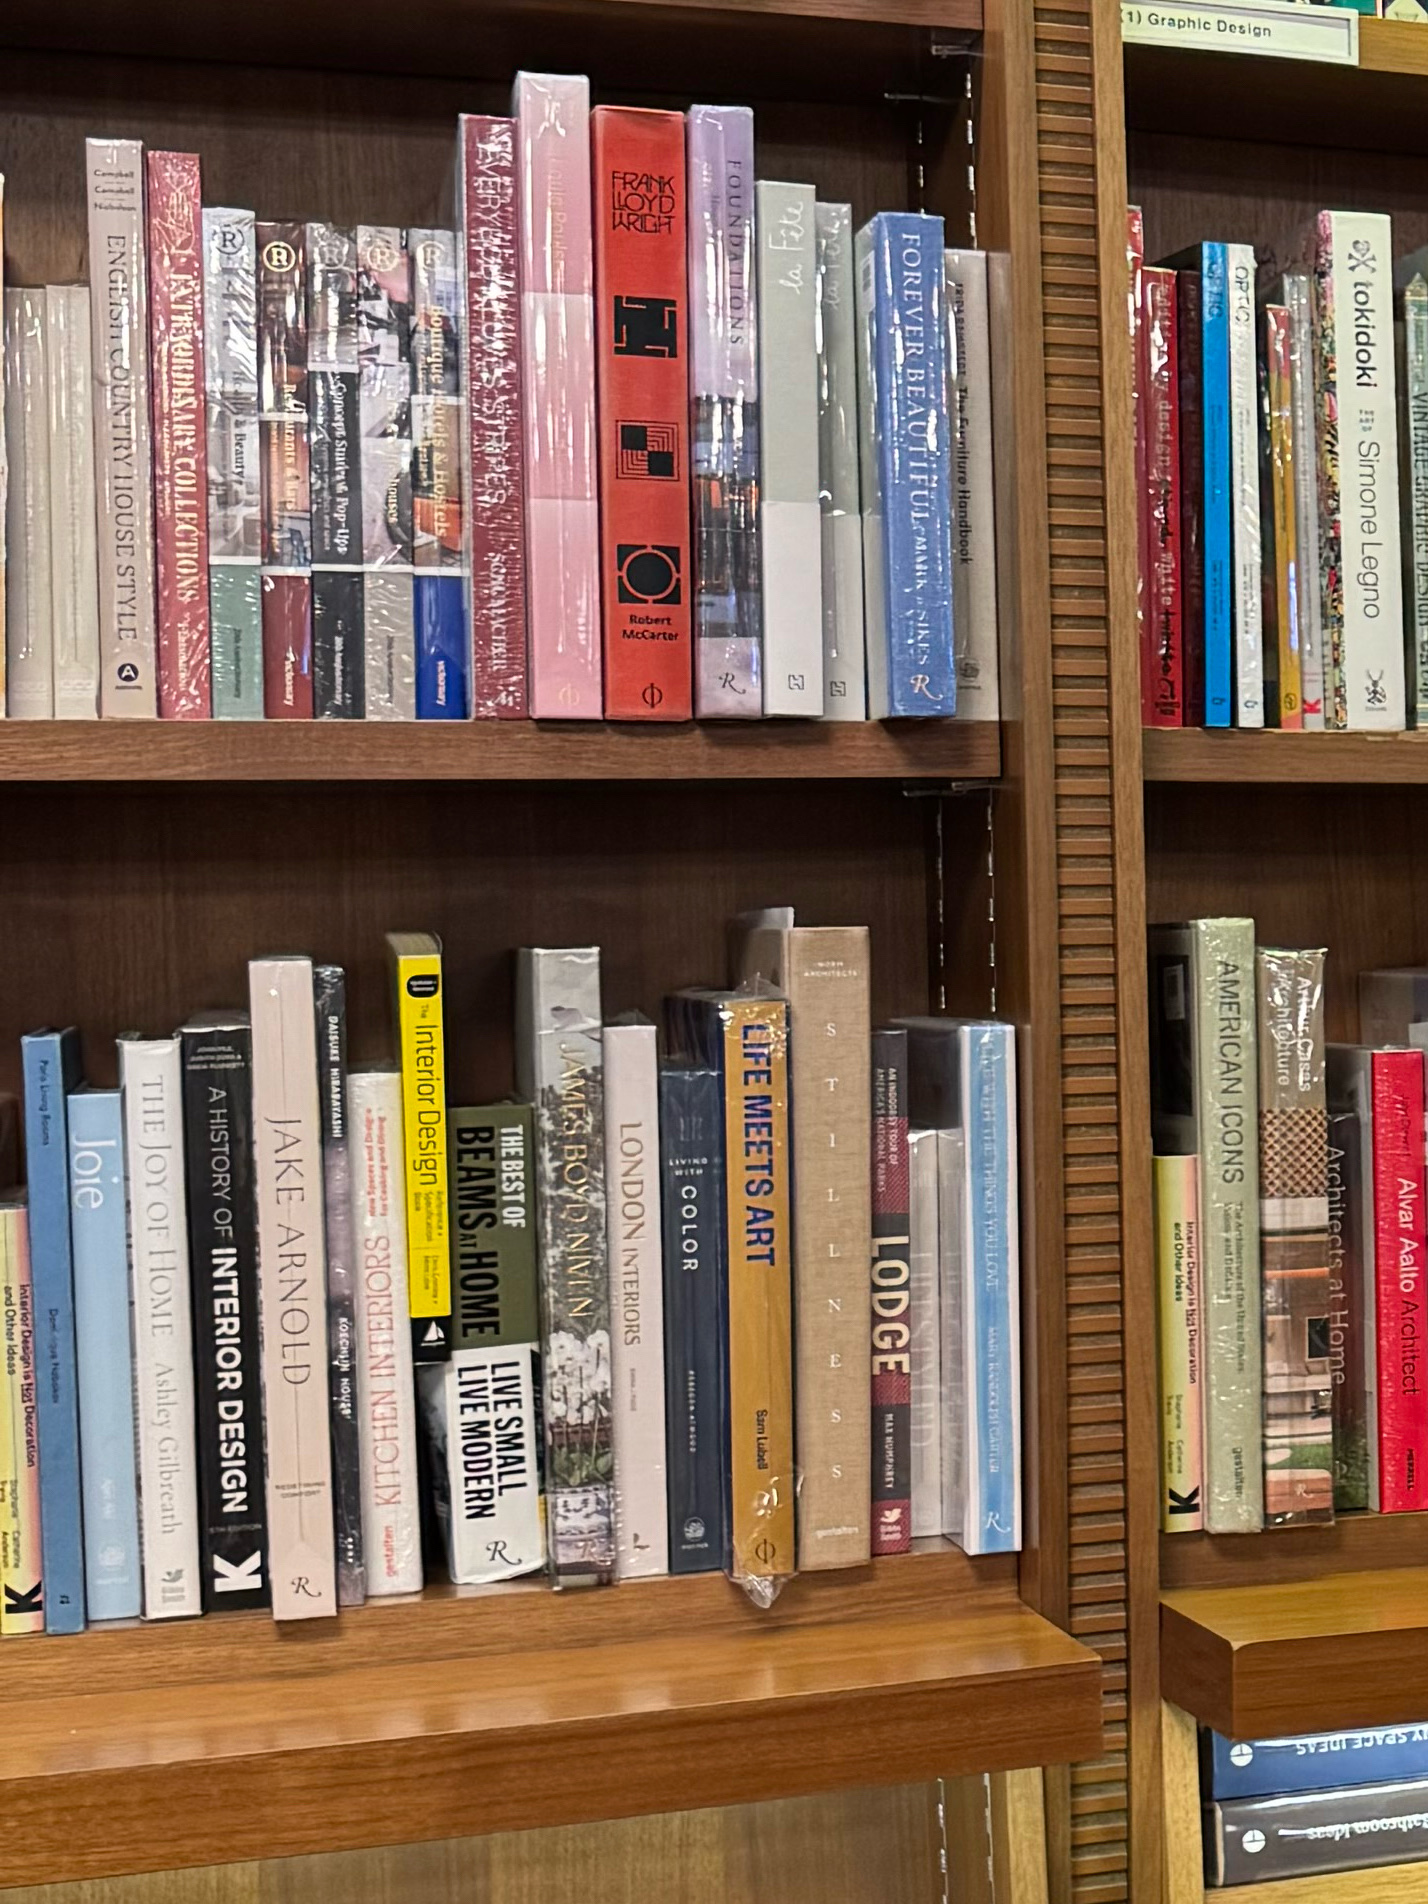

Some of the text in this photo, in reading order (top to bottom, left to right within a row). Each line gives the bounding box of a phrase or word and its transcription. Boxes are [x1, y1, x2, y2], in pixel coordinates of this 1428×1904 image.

[1148, 12, 1211, 31] Graphic
[1217, 19, 1272, 38] Design
[612, 171, 675, 195] FRANK
[612, 195, 676, 213] LLOYD
[612, 213, 675, 234] WRIGHT
[727, 159, 742, 346] FOUNDATIONS
[1352, 280, 1379, 388] tokidoki
[107, 235, 138, 642] ENGLISH COUNTRY HOUSE STYLE
[959, 387, 974, 566] The Furniture Handbook
[1357, 443, 1382, 620] Simone Legno
[622, 629, 679, 642] McCarter
[629, 613, 671, 627] Robert
[742, 1023, 775, 1267] LIFE MEETS ART
[1219, 960, 1244, 1186] AMERICAN ICONS
[72, 1134, 121, 1209] Joie
[208, 1086, 248, 1513] A HISTORY OF INTERIOR DESIGN
[264, 1116, 312, 1386] JAKE ARNOLD
[872, 1236, 910, 1376] LODGE
[1397, 1176, 1420, 1396] Alvar Aalto Architect
[457, 1365, 496, 1521] LIVE MODERN
[491, 1360, 529, 1497] LIVE SMALL
